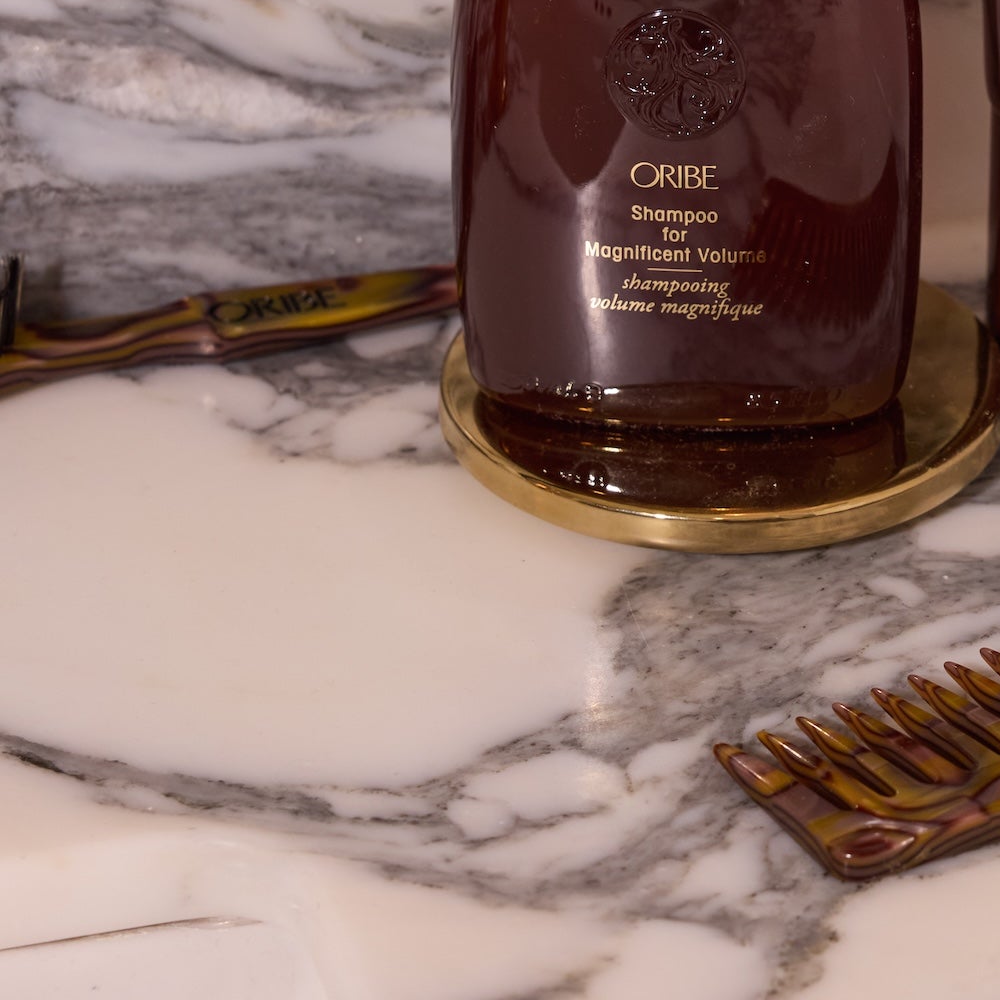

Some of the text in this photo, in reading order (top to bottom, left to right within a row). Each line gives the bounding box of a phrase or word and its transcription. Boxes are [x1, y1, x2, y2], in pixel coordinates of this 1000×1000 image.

[630, 161, 719, 190] ORIBE
[631, 204, 719, 226] Shampoo
[662, 226, 688, 243] for
[584, 240, 767, 264] Magnificent Volume
[622, 272, 730, 298] shampooing
[208, 286, 346, 323] ORIBE
[589, 293, 764, 321] volume magnifique
